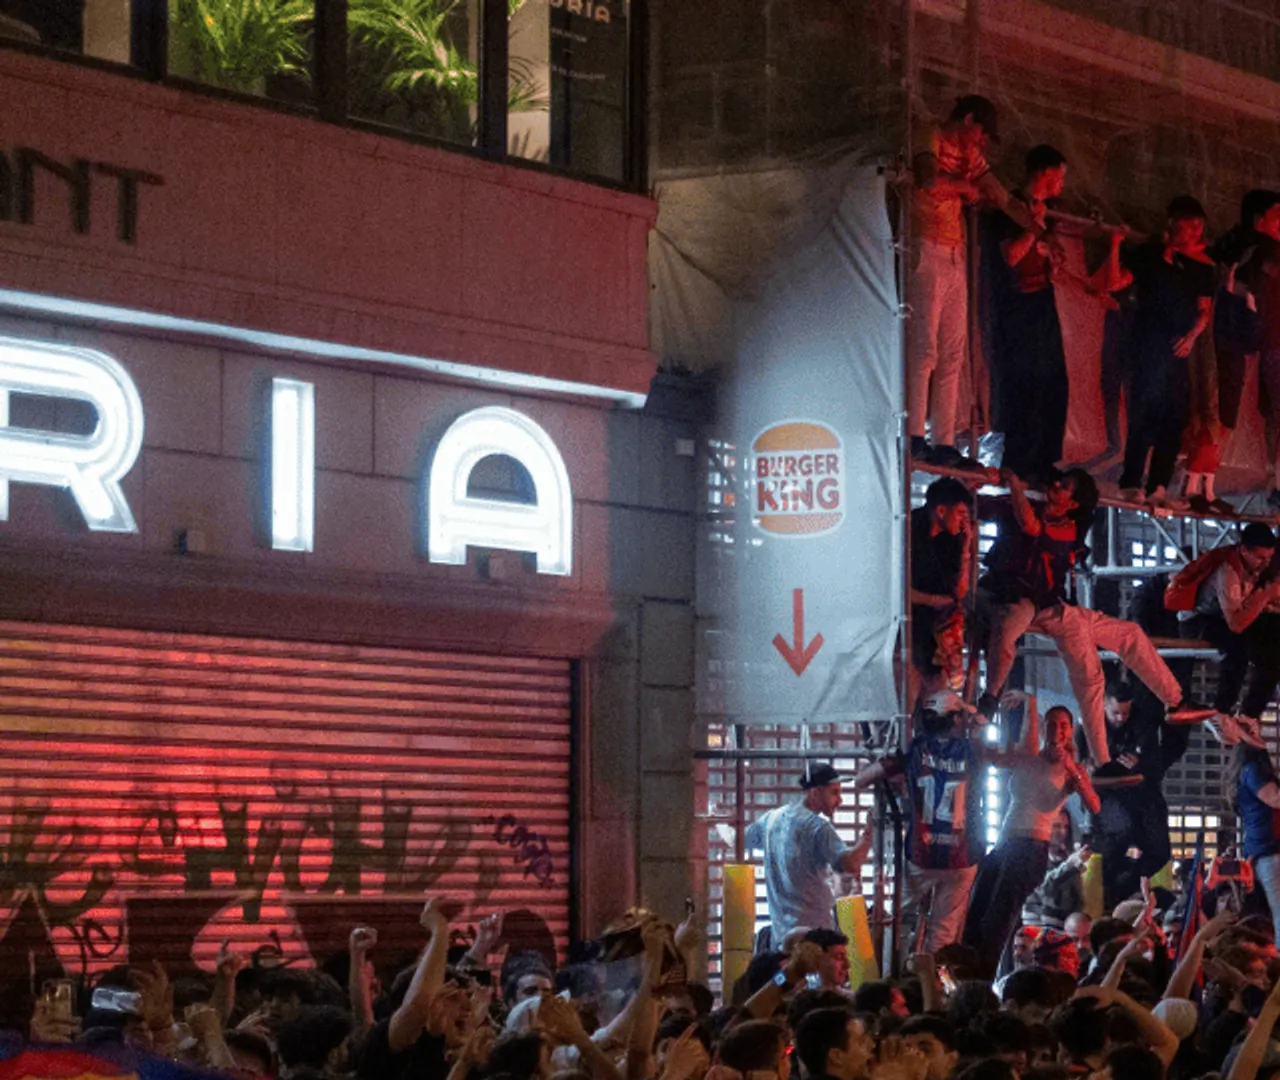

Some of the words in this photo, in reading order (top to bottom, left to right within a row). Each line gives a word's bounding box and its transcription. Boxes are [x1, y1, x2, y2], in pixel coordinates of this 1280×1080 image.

[0, 336, 573, 576] RIA
[757, 454, 839, 478] BURGER
[758, 478, 839, 511] KING
[917, 775, 966, 830] 14
